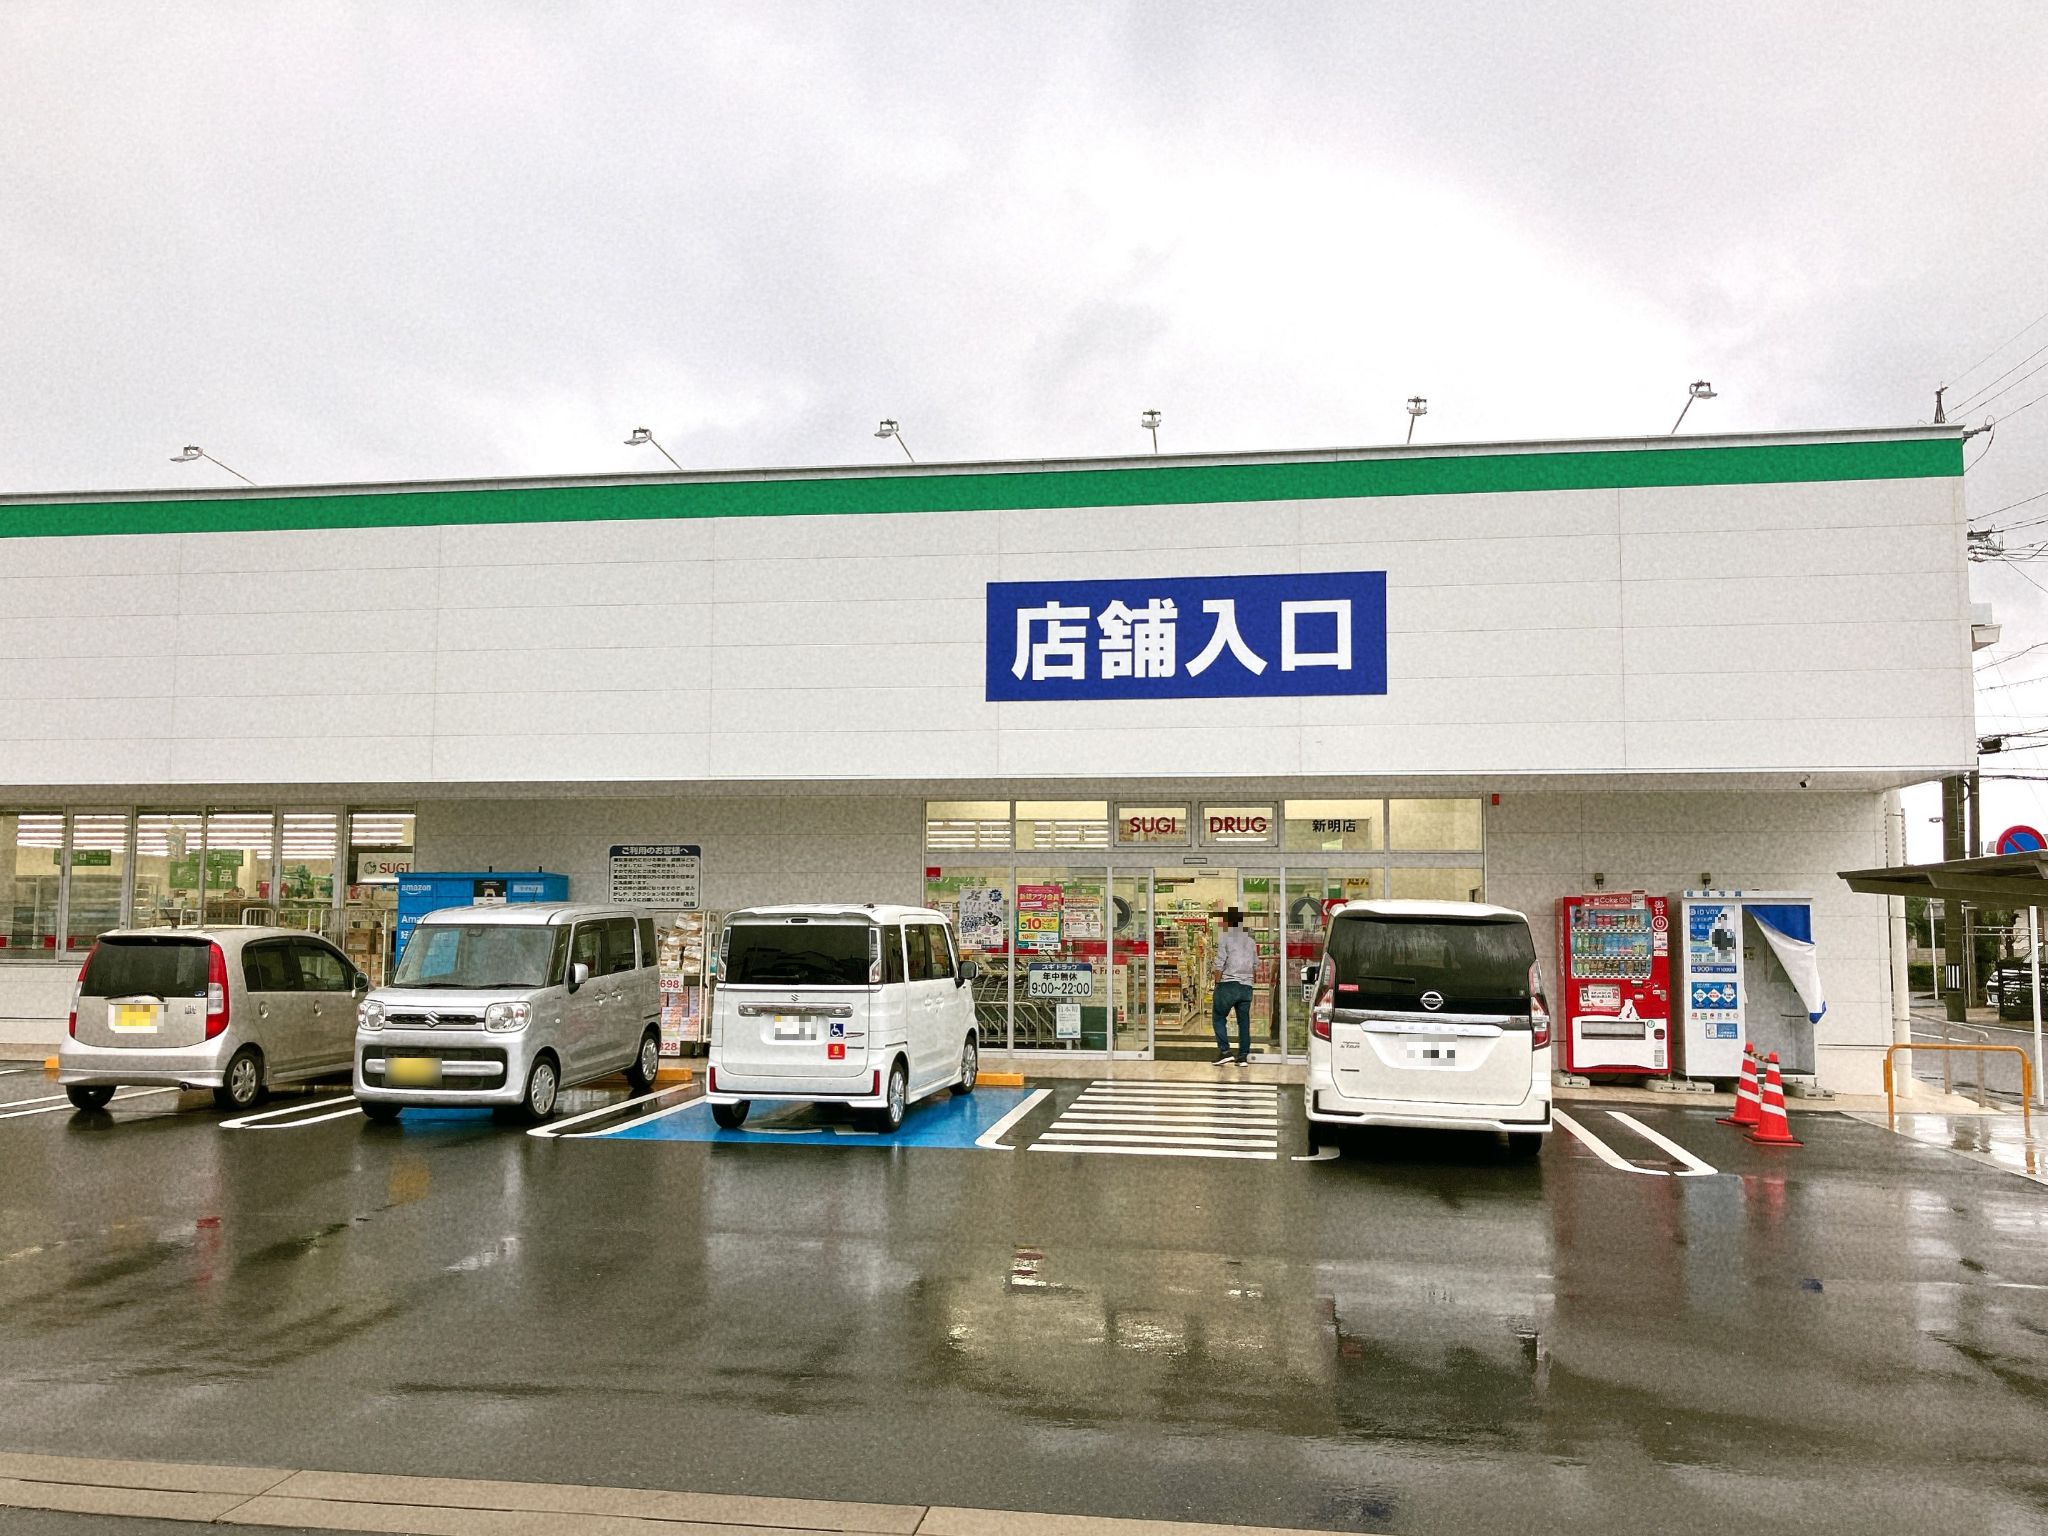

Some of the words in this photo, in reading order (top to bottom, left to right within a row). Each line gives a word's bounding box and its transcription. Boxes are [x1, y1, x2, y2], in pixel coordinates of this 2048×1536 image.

[1011, 598, 1352, 681] 店舗入口
[1129, 816, 1176, 833] SUGI
[1209, 816, 1267, 833] DRUG
[1312, 819, 1356, 833] 新明店
[621, 846, 689, 855] ご利用のお客様へ
[379, 863, 411, 874] SUGI
[401, 884, 431, 892] amazon
[1599, 896, 1618, 904] Coke
[401, 915, 421, 924] Ama
[1026, 917, 1041, 930] 10
[1100, 967, 1120, 975] Fre
[1043, 972, 1078, 981] 年中無休
[1031, 982, 1090, 995] 9:00~22:00
